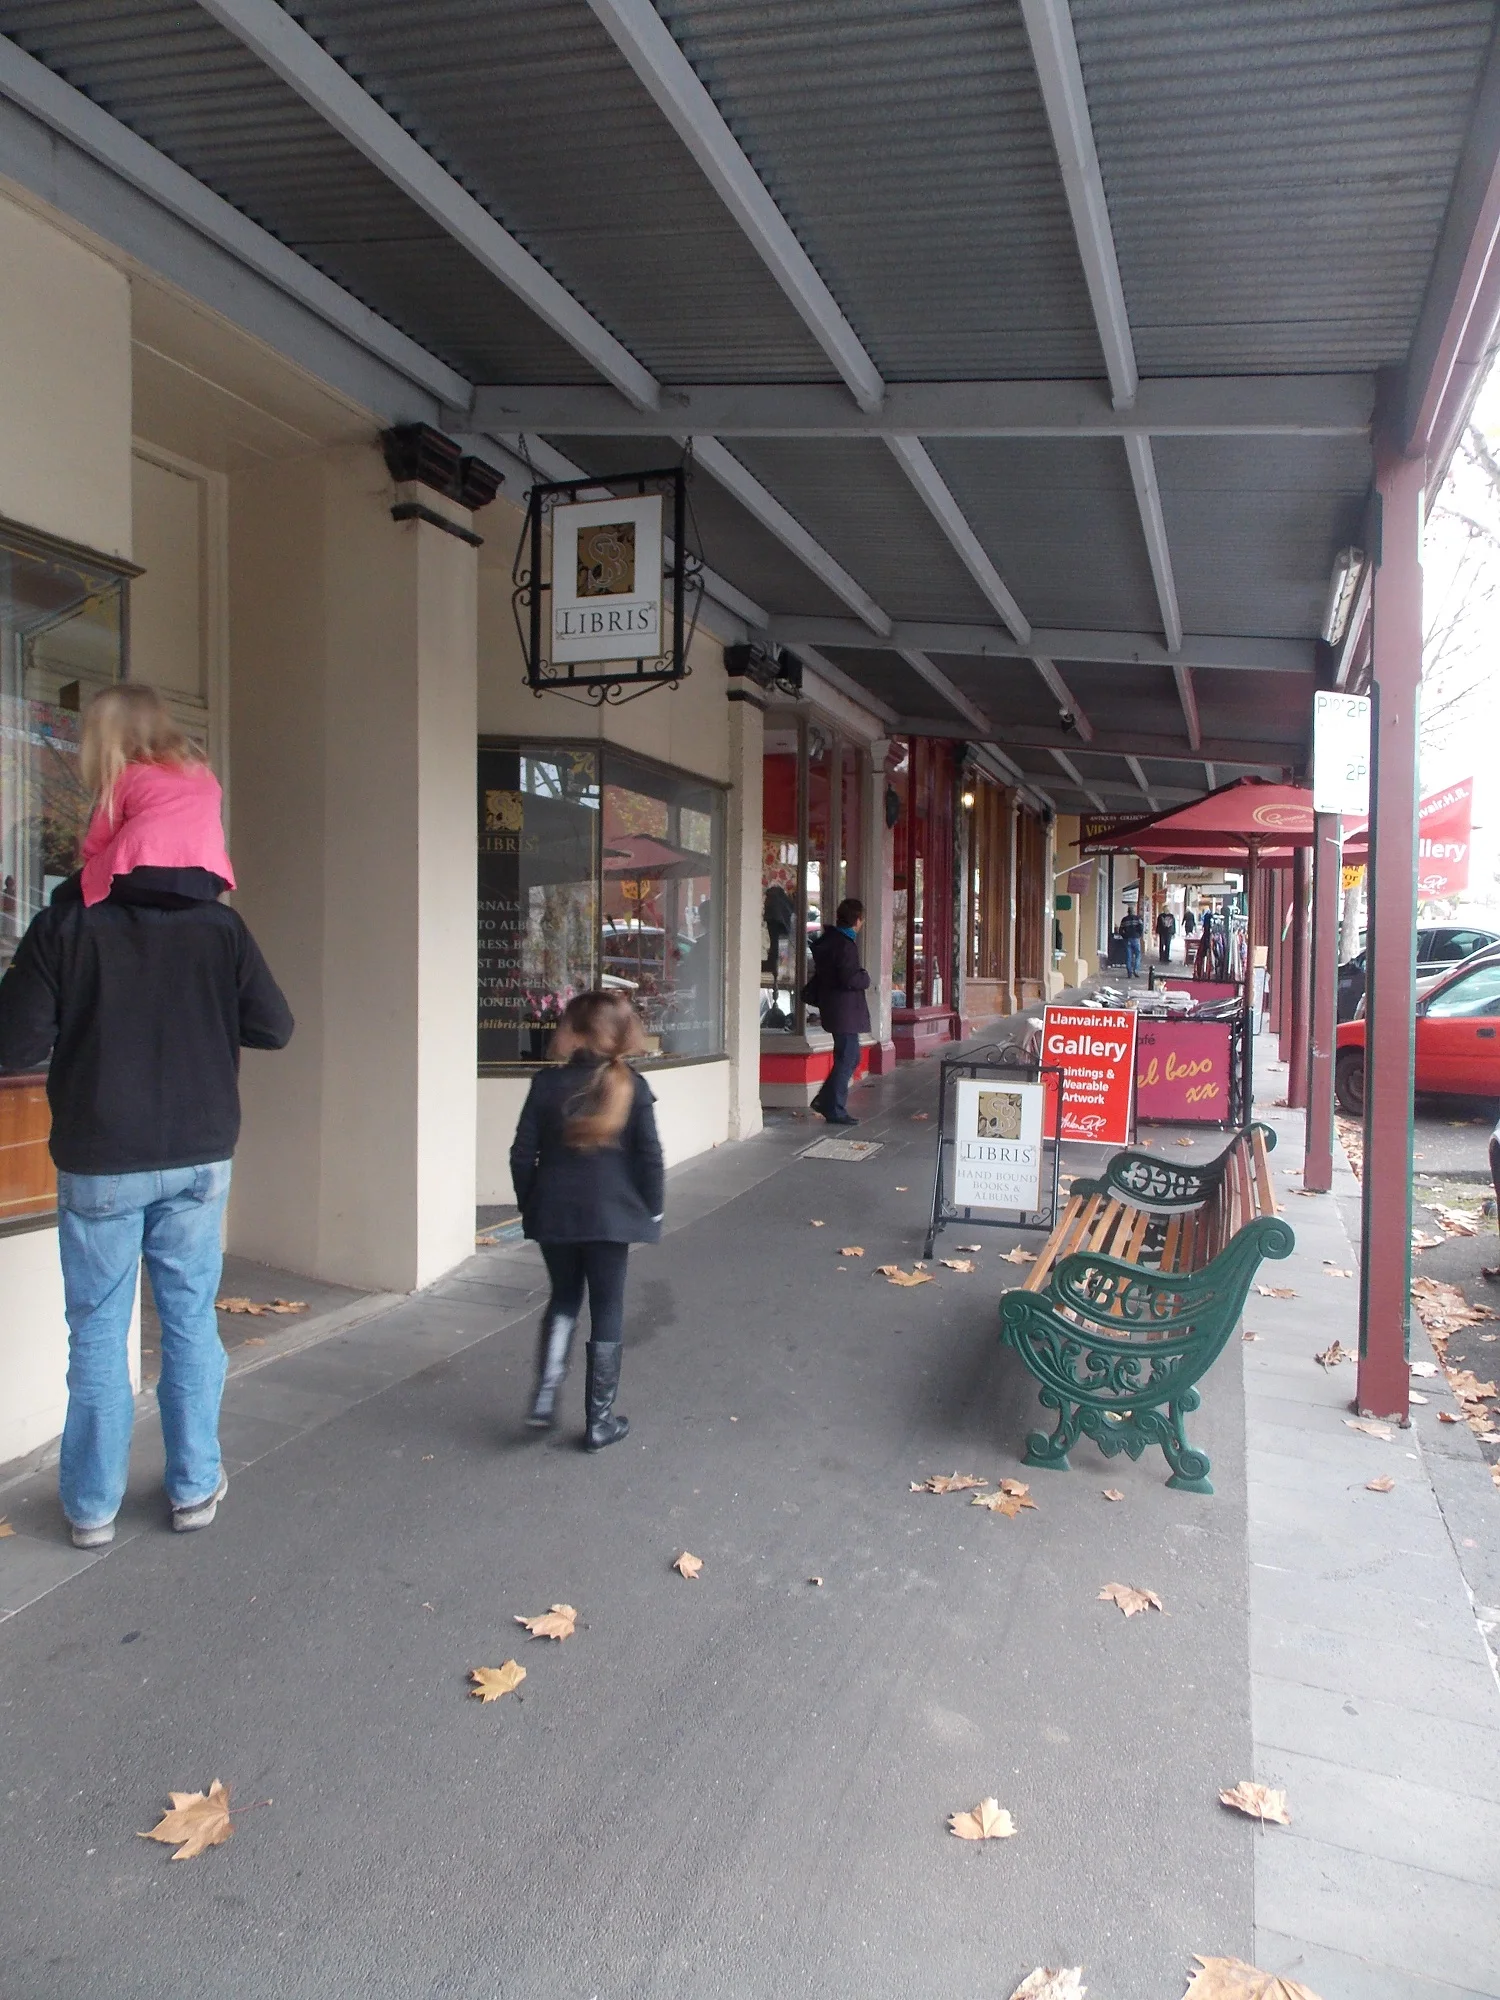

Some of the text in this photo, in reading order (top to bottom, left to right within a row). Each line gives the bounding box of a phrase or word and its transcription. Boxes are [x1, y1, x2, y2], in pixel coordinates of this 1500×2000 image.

[564, 608, 649, 635] LIBRIS
[1346, 763, 1367, 781] 2P
[1418, 838, 1467, 863] llery
[478, 901, 520, 911] RNALS
[478, 940, 509, 949] RESS
[478, 959, 492, 969] ST
[478, 979, 520, 988] NTAIN
[1050, 1013, 1129, 1029] Llanvair.H.R.
[1048, 1035, 1127, 1063] Gallery
[1062, 1066, 1115, 1080] aintings &
[1137, 1052, 1212, 1088] el beso
[1062, 1091, 1105, 1105] Artwork
[1186, 1082, 1220, 1103] xx
[966, 1144, 1031, 1163] LIBRIS
[957, 1169, 1037, 1184] HAND BOUND
[973, 1181, 1010, 1192] BOOKS
[974, 1192, 1019, 1203] ALBUMS
